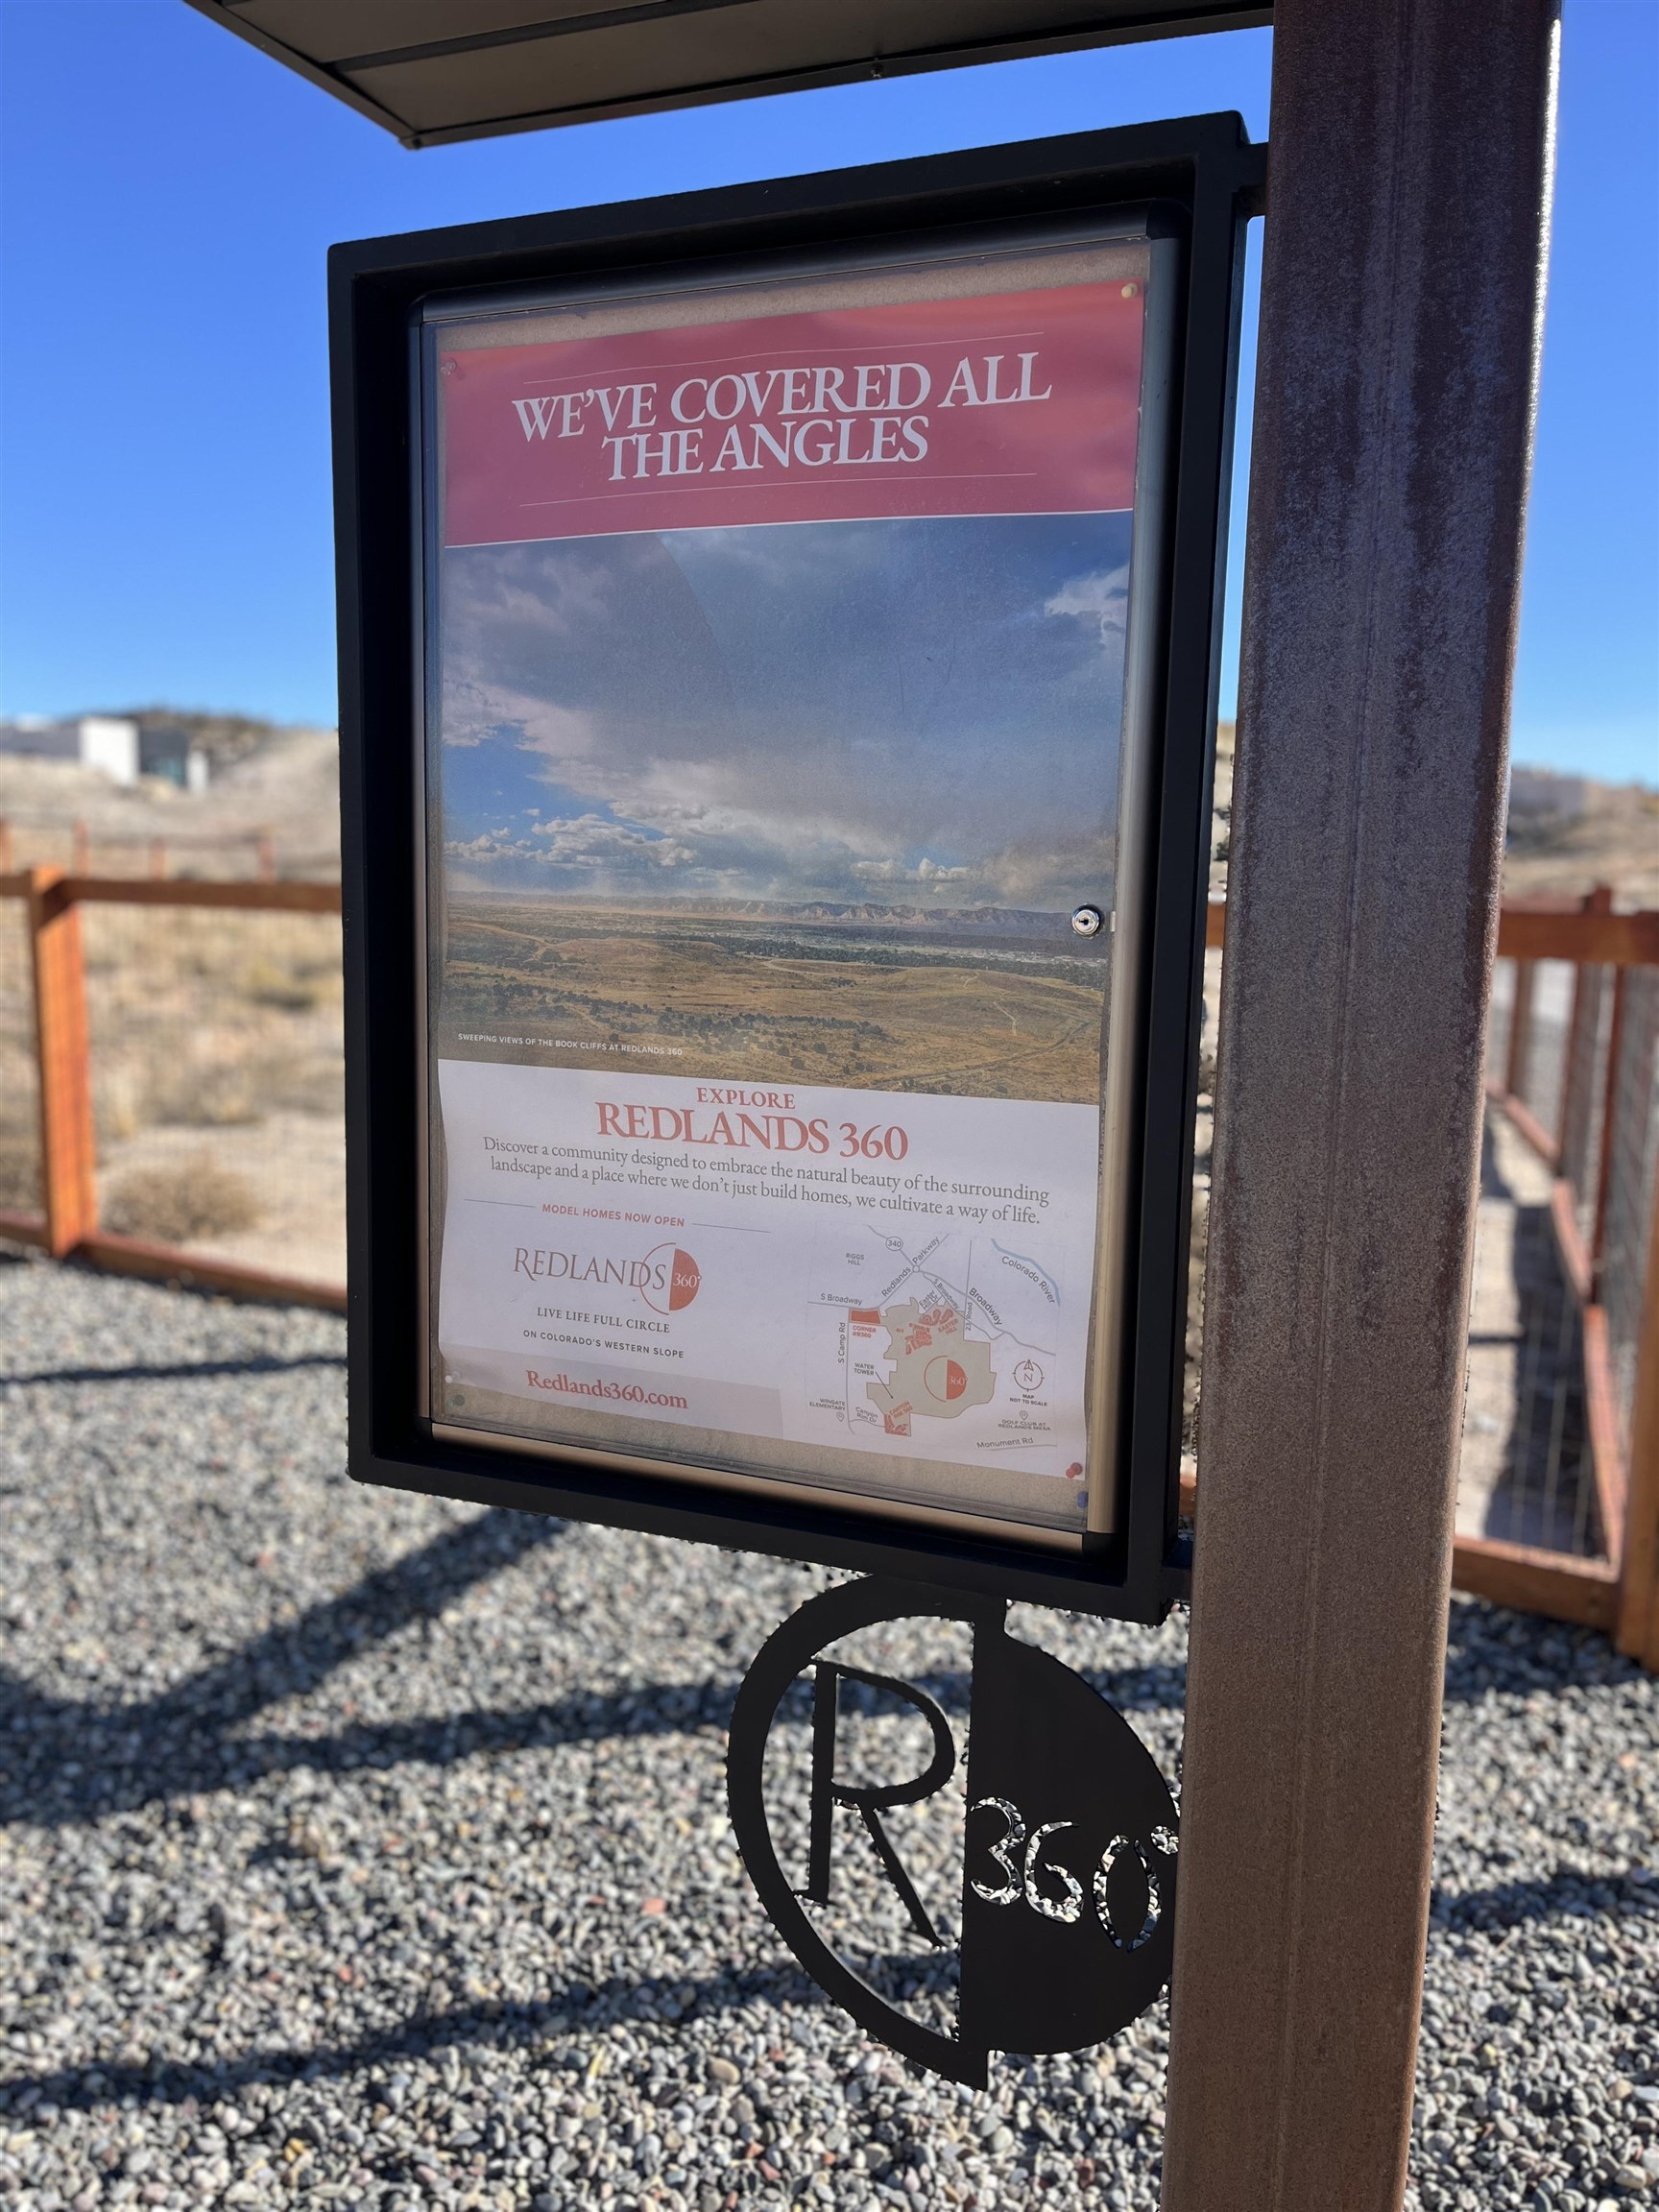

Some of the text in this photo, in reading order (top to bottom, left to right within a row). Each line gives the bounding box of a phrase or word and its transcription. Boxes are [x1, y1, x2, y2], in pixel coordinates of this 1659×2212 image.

[671, 362, 932, 426] COVERED
[937, 351, 1053, 409] ALL
[601, 415, 929, 481] THE ANGLES
[457, 1032, 497, 1044] SWEEPING
[499, 1035, 523, 1045] VIEWS
[525, 1037, 537, 1046] OF
[538, 1038, 554, 1047] THE
[555, 1039, 578, 1048] BOOK
[580, 1041, 607, 1051] CLIFFS
[620, 1044, 665, 1055] REDLANDS
[666, 1047, 683, 1056] 360
[696, 1087, 796, 1110] EXPLORE
[595, 1101, 908, 1161] REDLANDS 360
[483, 1136, 1050, 1208] Discover a community designed to embrace the natural beauty of the surrounding
[491, 1156, 552, 1179] landscape
[554, 1166, 579, 1178] and
[582, 1170, 589, 1179] a
[591, 1166, 625, 1185] place
[627, 1172, 668, 1188] where
[671, 1178, 689, 1190] we
[732, 1179, 758, 1197] just
[760, 1183, 798, 1200] build
[801, 1185, 853, 1208] homes,
[855, 1195, 877, 1208] we
[878, 1195, 943, 1215] cultivate
[946, 1204, 955, 1215] a
[958, 1206, 989, 1224] way
[992, 1205, 1011, 1222] of
[1012, 1206, 1041, 1225] life.
[541, 1203, 685, 1228] MODEL HOMES NOW OPEN
[887, 1239, 902, 1248] 340
[845, 1252, 865, 1261] RIGGS
[881, 1236, 941, 1297] Redlands Parkway
[513, 1247, 667, 1290] REDLANDS
[1000, 1255, 1057, 1305] Colorado River
[820, 1292, 863, 1307] S Broadway
[918, 1289, 936, 1307] Easter
[923, 1299, 934, 1311] Hill
[936, 1282, 961, 1310] Broadway
[969, 1286, 1003, 1326] Broadway
[537, 1307, 671, 1334] LIVE LIFE FULL CIRCLE
[838, 1321, 846, 1333] Rd
[852, 1325, 877, 1334] CORNER
[937, 1318, 959, 1334] EASTER
[965, 1321, 972, 1332] 23
[523, 1329, 538, 1339] ON
[604, 1340, 651, 1355] WESTERN
[653, 1346, 685, 1359] SLOPE
[525, 1369, 688, 1409] Redlands360.com
[1023, 1373, 1034, 1383] N
[808, 1401, 846, 1411] ELEMENTARY
[819, 1398, 846, 1407] WINGATE
[855, 1407, 878, 1418] Canyon
[856, 1412, 869, 1421] Rim
[976, 1438, 1022, 1449] Monument
